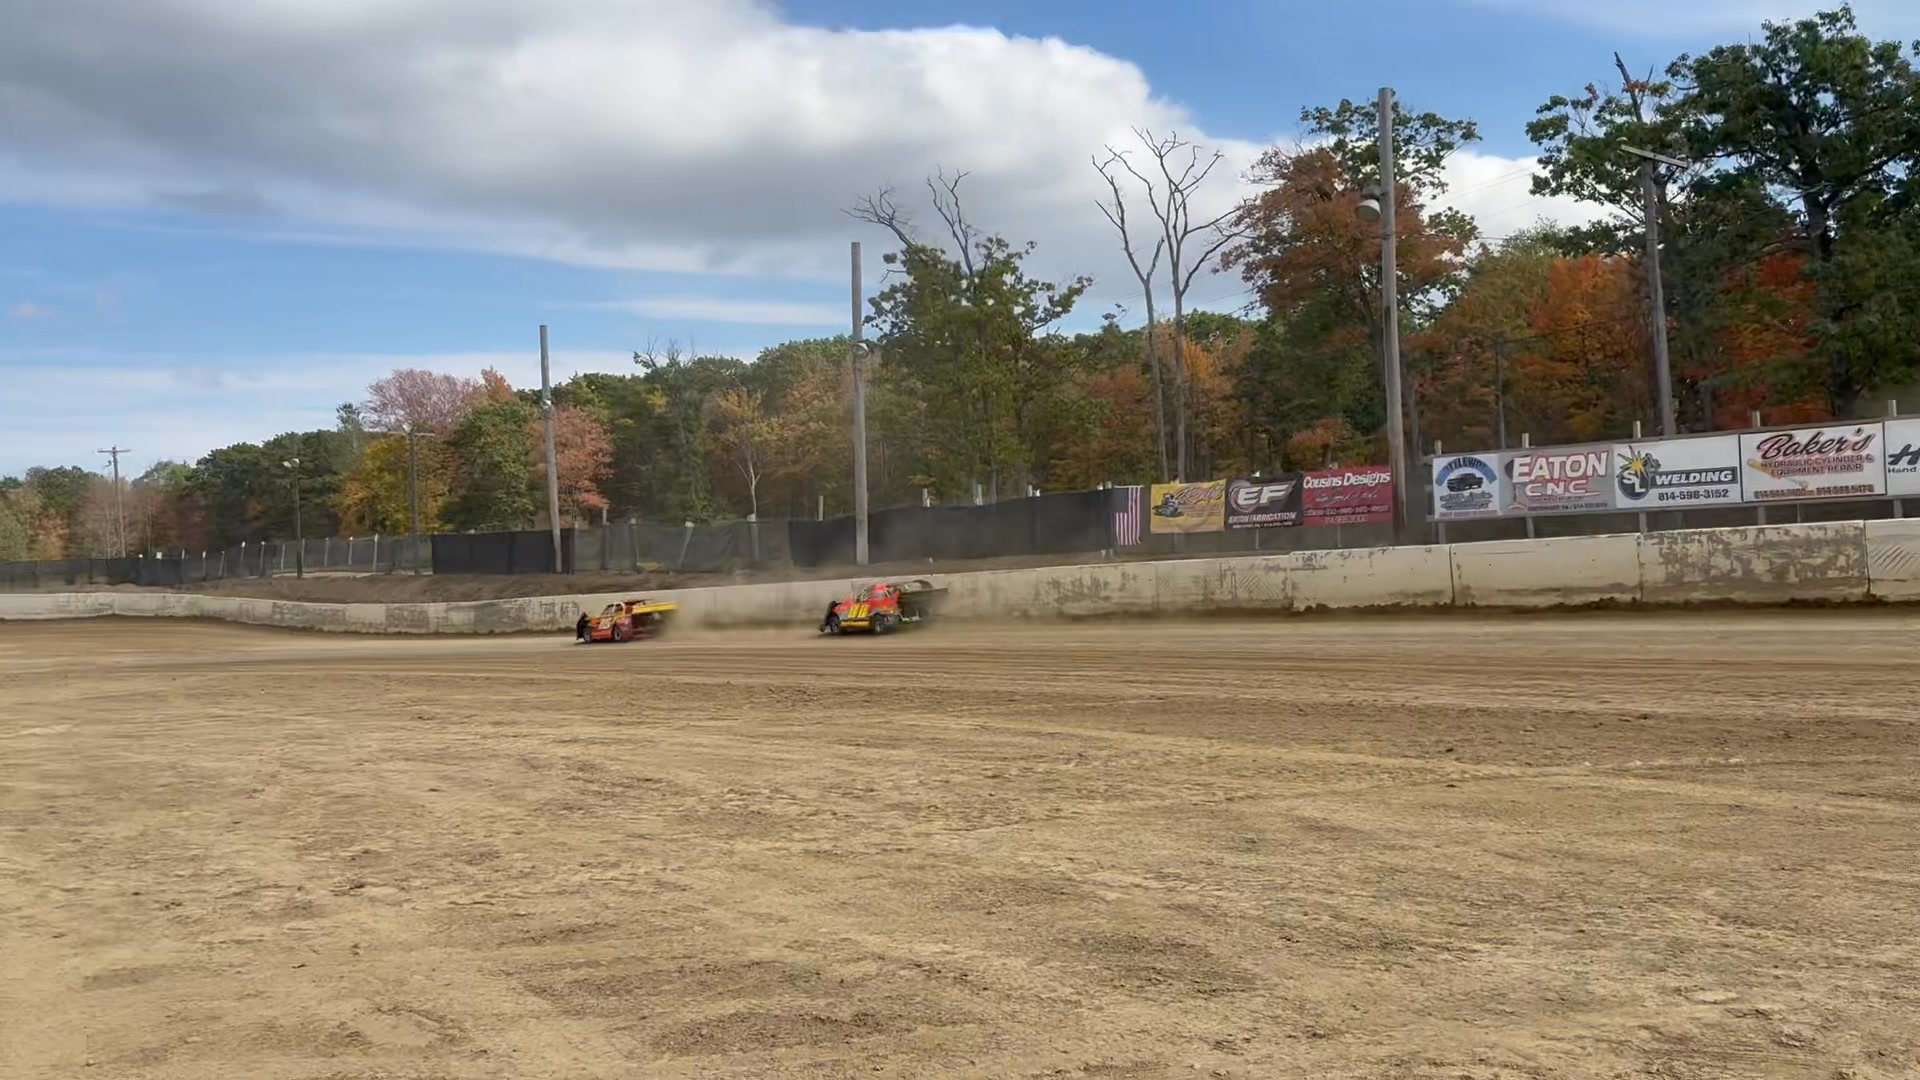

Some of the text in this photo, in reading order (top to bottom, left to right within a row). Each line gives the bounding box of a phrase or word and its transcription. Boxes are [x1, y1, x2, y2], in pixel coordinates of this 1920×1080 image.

[1756, 428, 1876, 460] Baker's
[1512, 451, 1608, 482] EATON
[1827, 464, 1863, 474] REPAIR
[1303, 471, 1391, 489] Cousins Designs
[1654, 470, 1733, 486] WELDING
[1237, 483, 1289, 506] EF
[1525, 479, 1588, 496] CNC
[1250, 511, 1297, 523] FABRICATION
